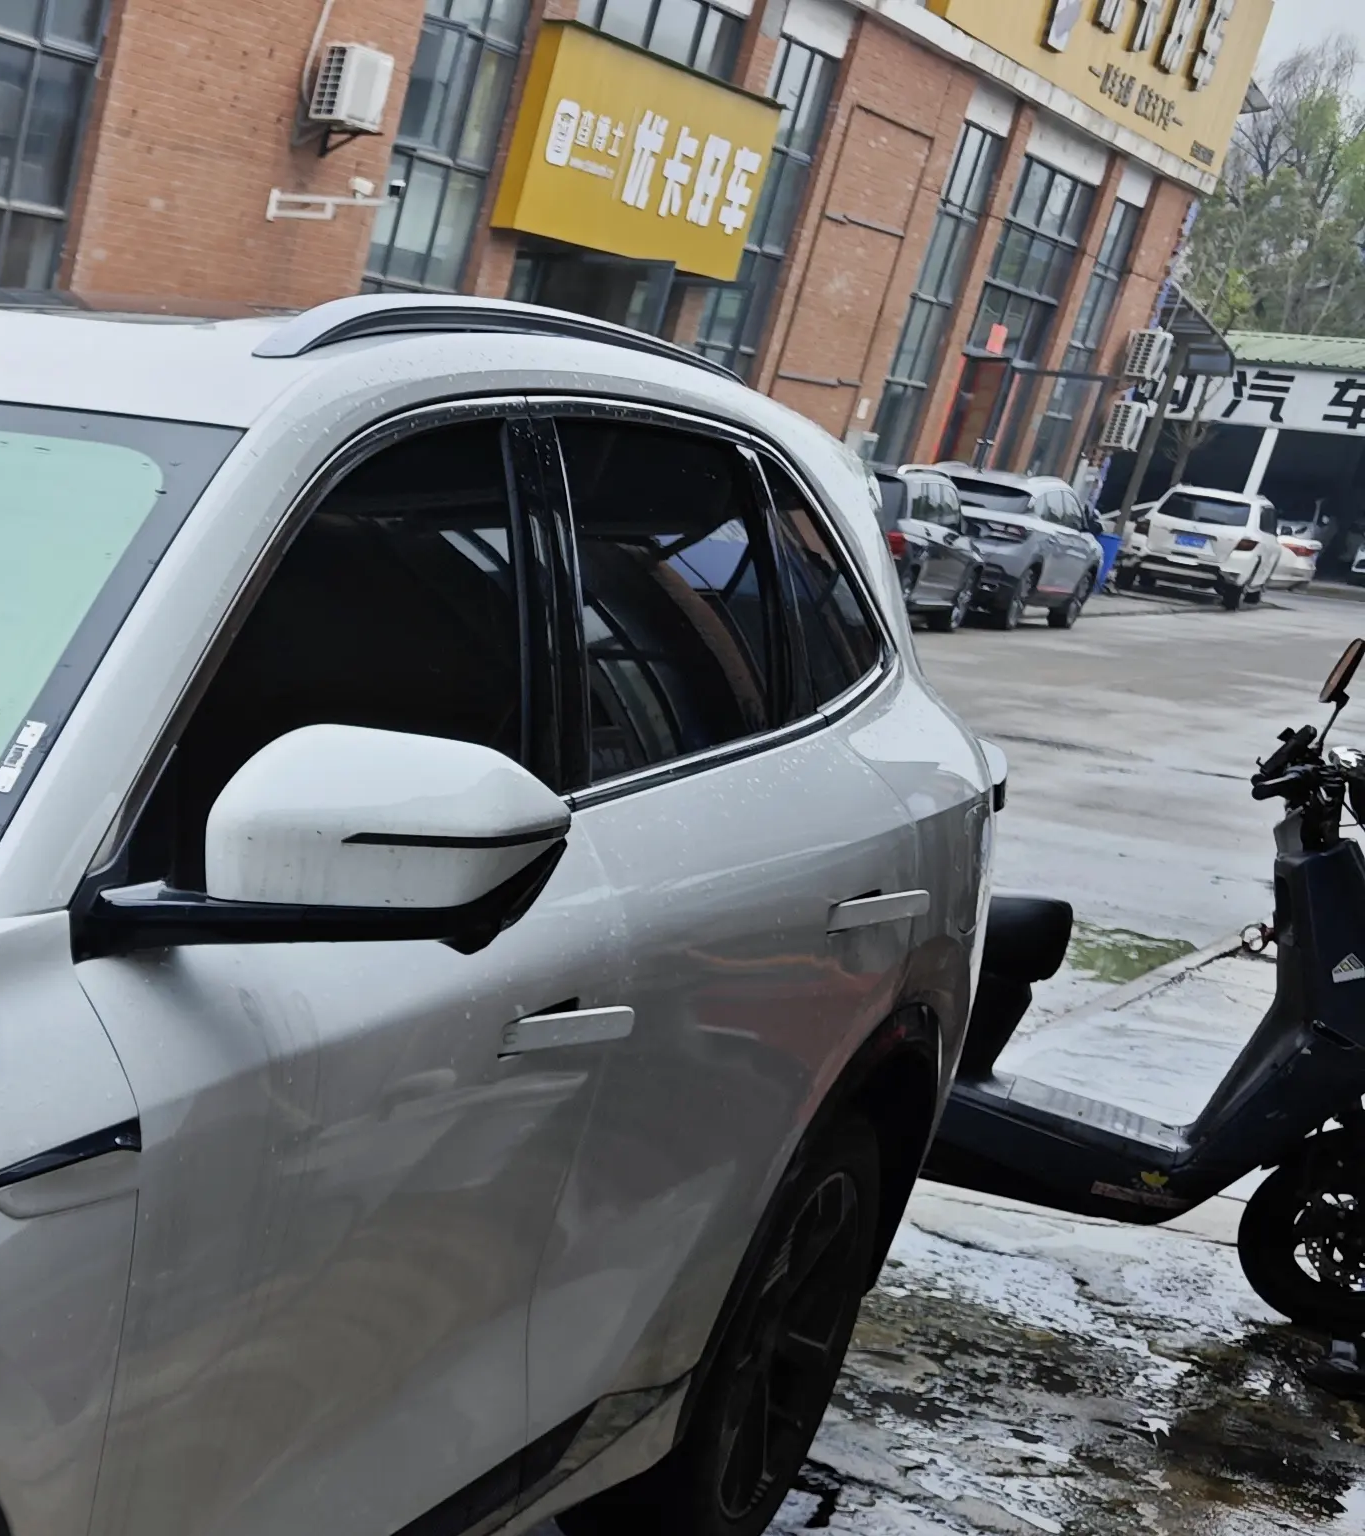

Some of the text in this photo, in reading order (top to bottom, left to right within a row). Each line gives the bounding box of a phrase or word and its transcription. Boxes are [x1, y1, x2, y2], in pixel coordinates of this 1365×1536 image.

[574, 109, 762, 236] 查博士 优卡好车
